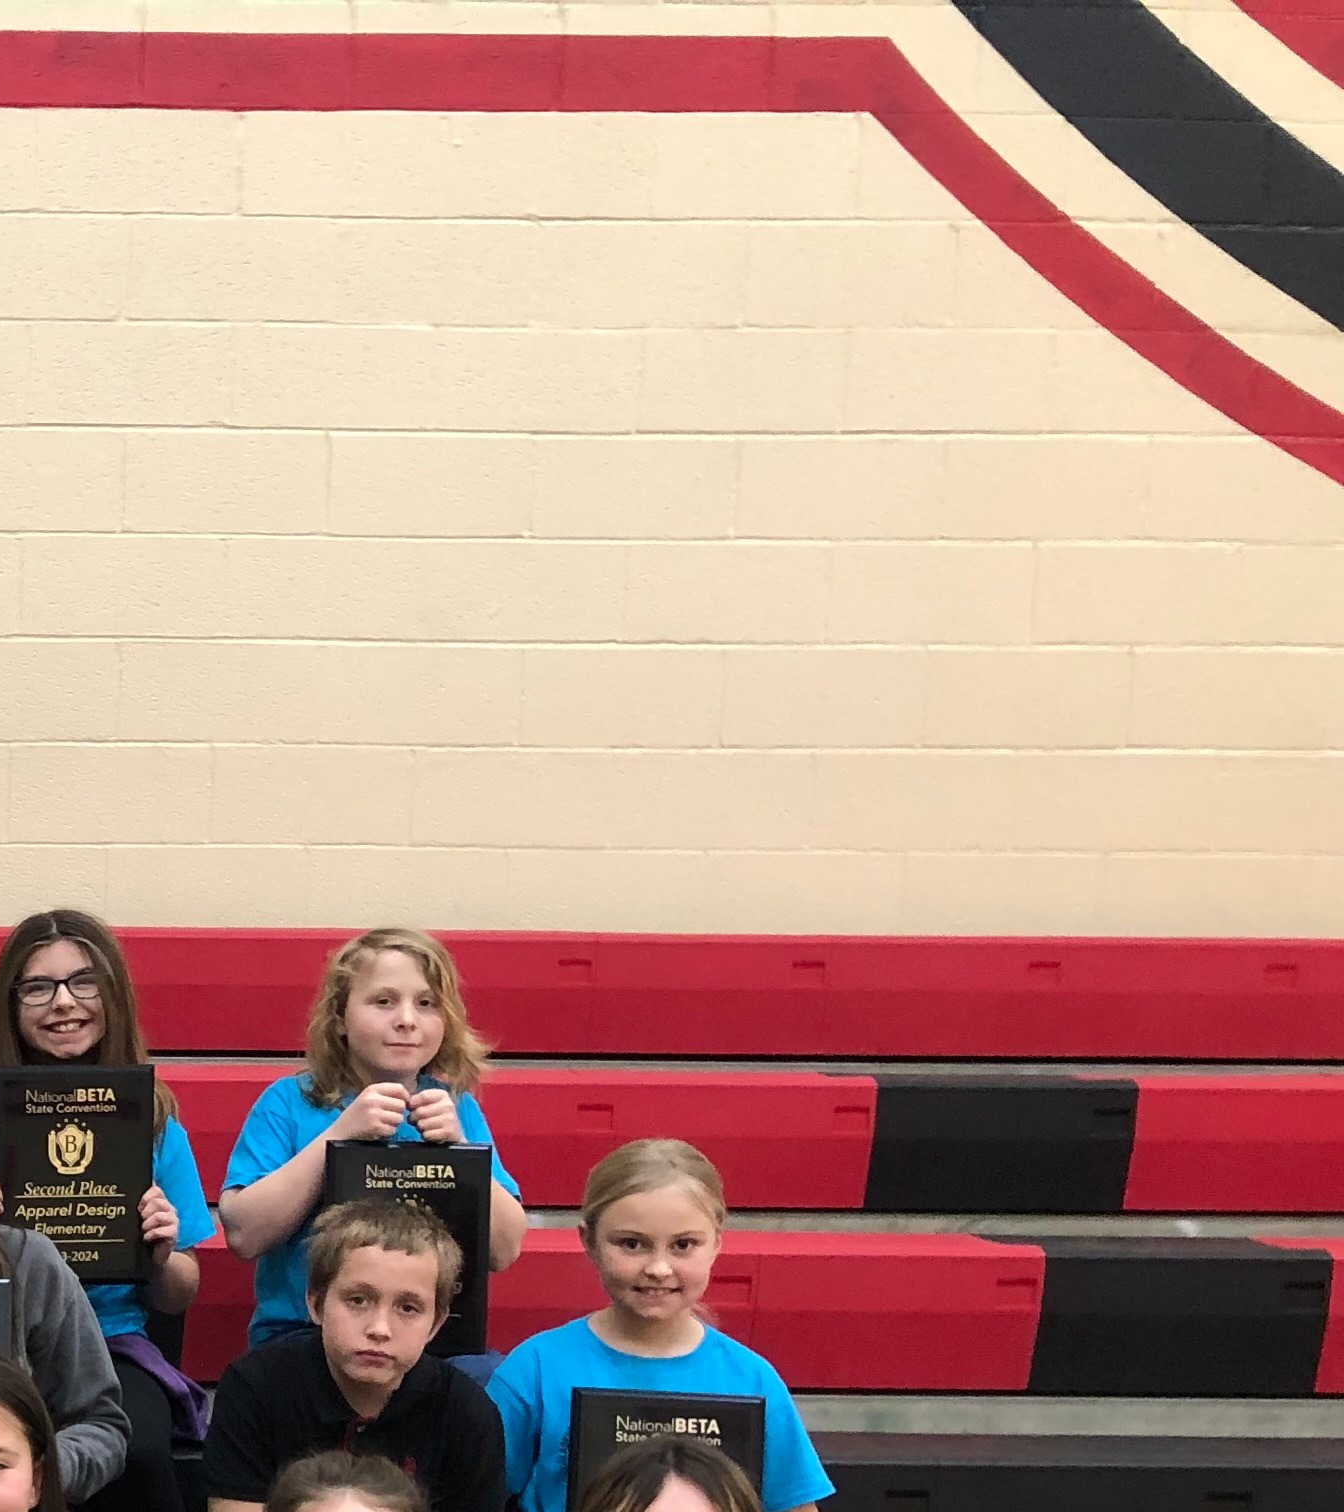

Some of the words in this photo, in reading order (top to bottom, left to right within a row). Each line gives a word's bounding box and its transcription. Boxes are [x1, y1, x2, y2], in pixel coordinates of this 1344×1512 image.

[25, 1088, 115, 1103] NationalBETA
[26, 1104, 53, 1113] State
[56, 1104, 116, 1113] Convention
[365, 1164, 455, 1179] NationalBETA
[24, 1181, 75, 1197] Second
[80, 1183, 117, 1196] Place
[365, 1180, 393, 1189] State
[396, 1180, 455, 1189] Convention
[15, 1204, 72, 1219] Apparel
[77, 1203, 125, 1219] Design
[35, 1223, 106, 1237] Elementary
[61, 1251, 98, 1262] 3-2024
[616, 1415, 721, 1434] NationalBETA
